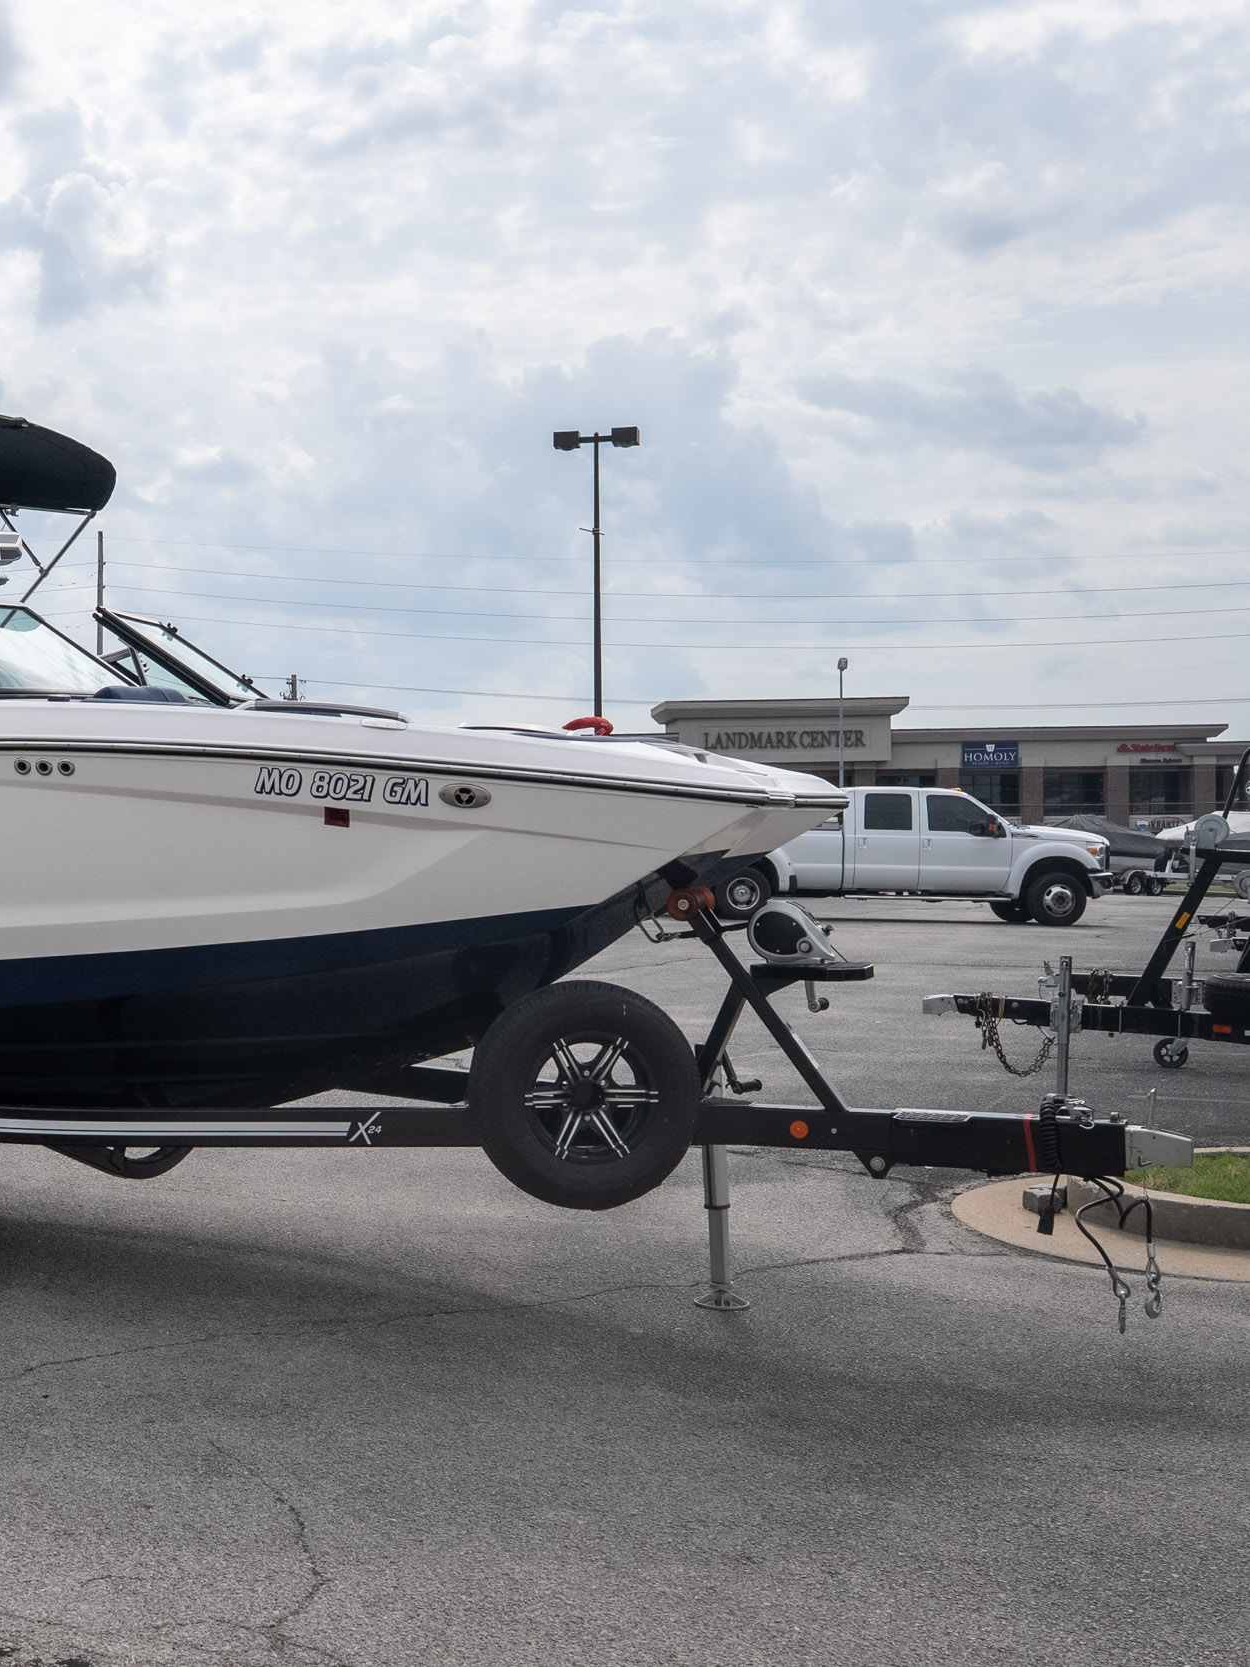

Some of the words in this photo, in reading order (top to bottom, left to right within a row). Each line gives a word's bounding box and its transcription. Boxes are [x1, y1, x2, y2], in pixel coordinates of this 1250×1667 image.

[703, 731, 798, 750] LANDMARK
[799, 730, 866, 749] CENTER
[964, 751, 1017, 762] HOMOLY
[254, 766, 303, 797] MO
[310, 771, 376, 803] 8021
[382, 776, 430, 807] GM
